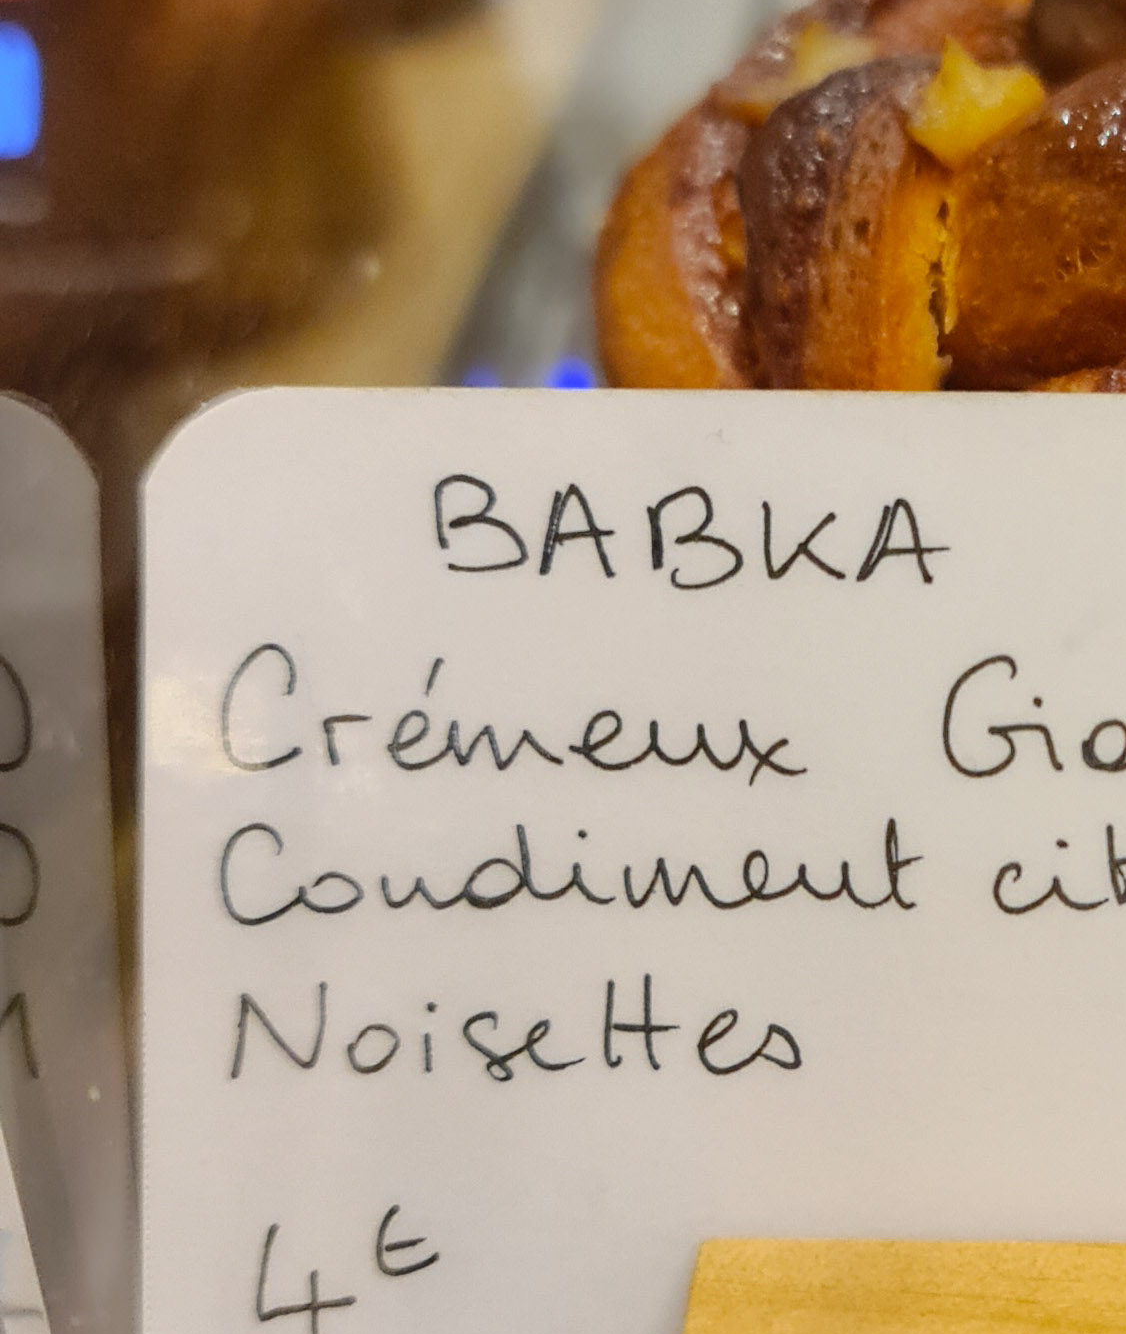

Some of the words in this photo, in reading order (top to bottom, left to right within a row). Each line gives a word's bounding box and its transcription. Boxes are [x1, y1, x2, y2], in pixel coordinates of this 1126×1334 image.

[434, 474, 950, 590] BABKA
[222, 643, 808, 787] Crémeux
[220, 817, 923, 926] Condiment
[230, 973, 802, 1082] Noisettes
